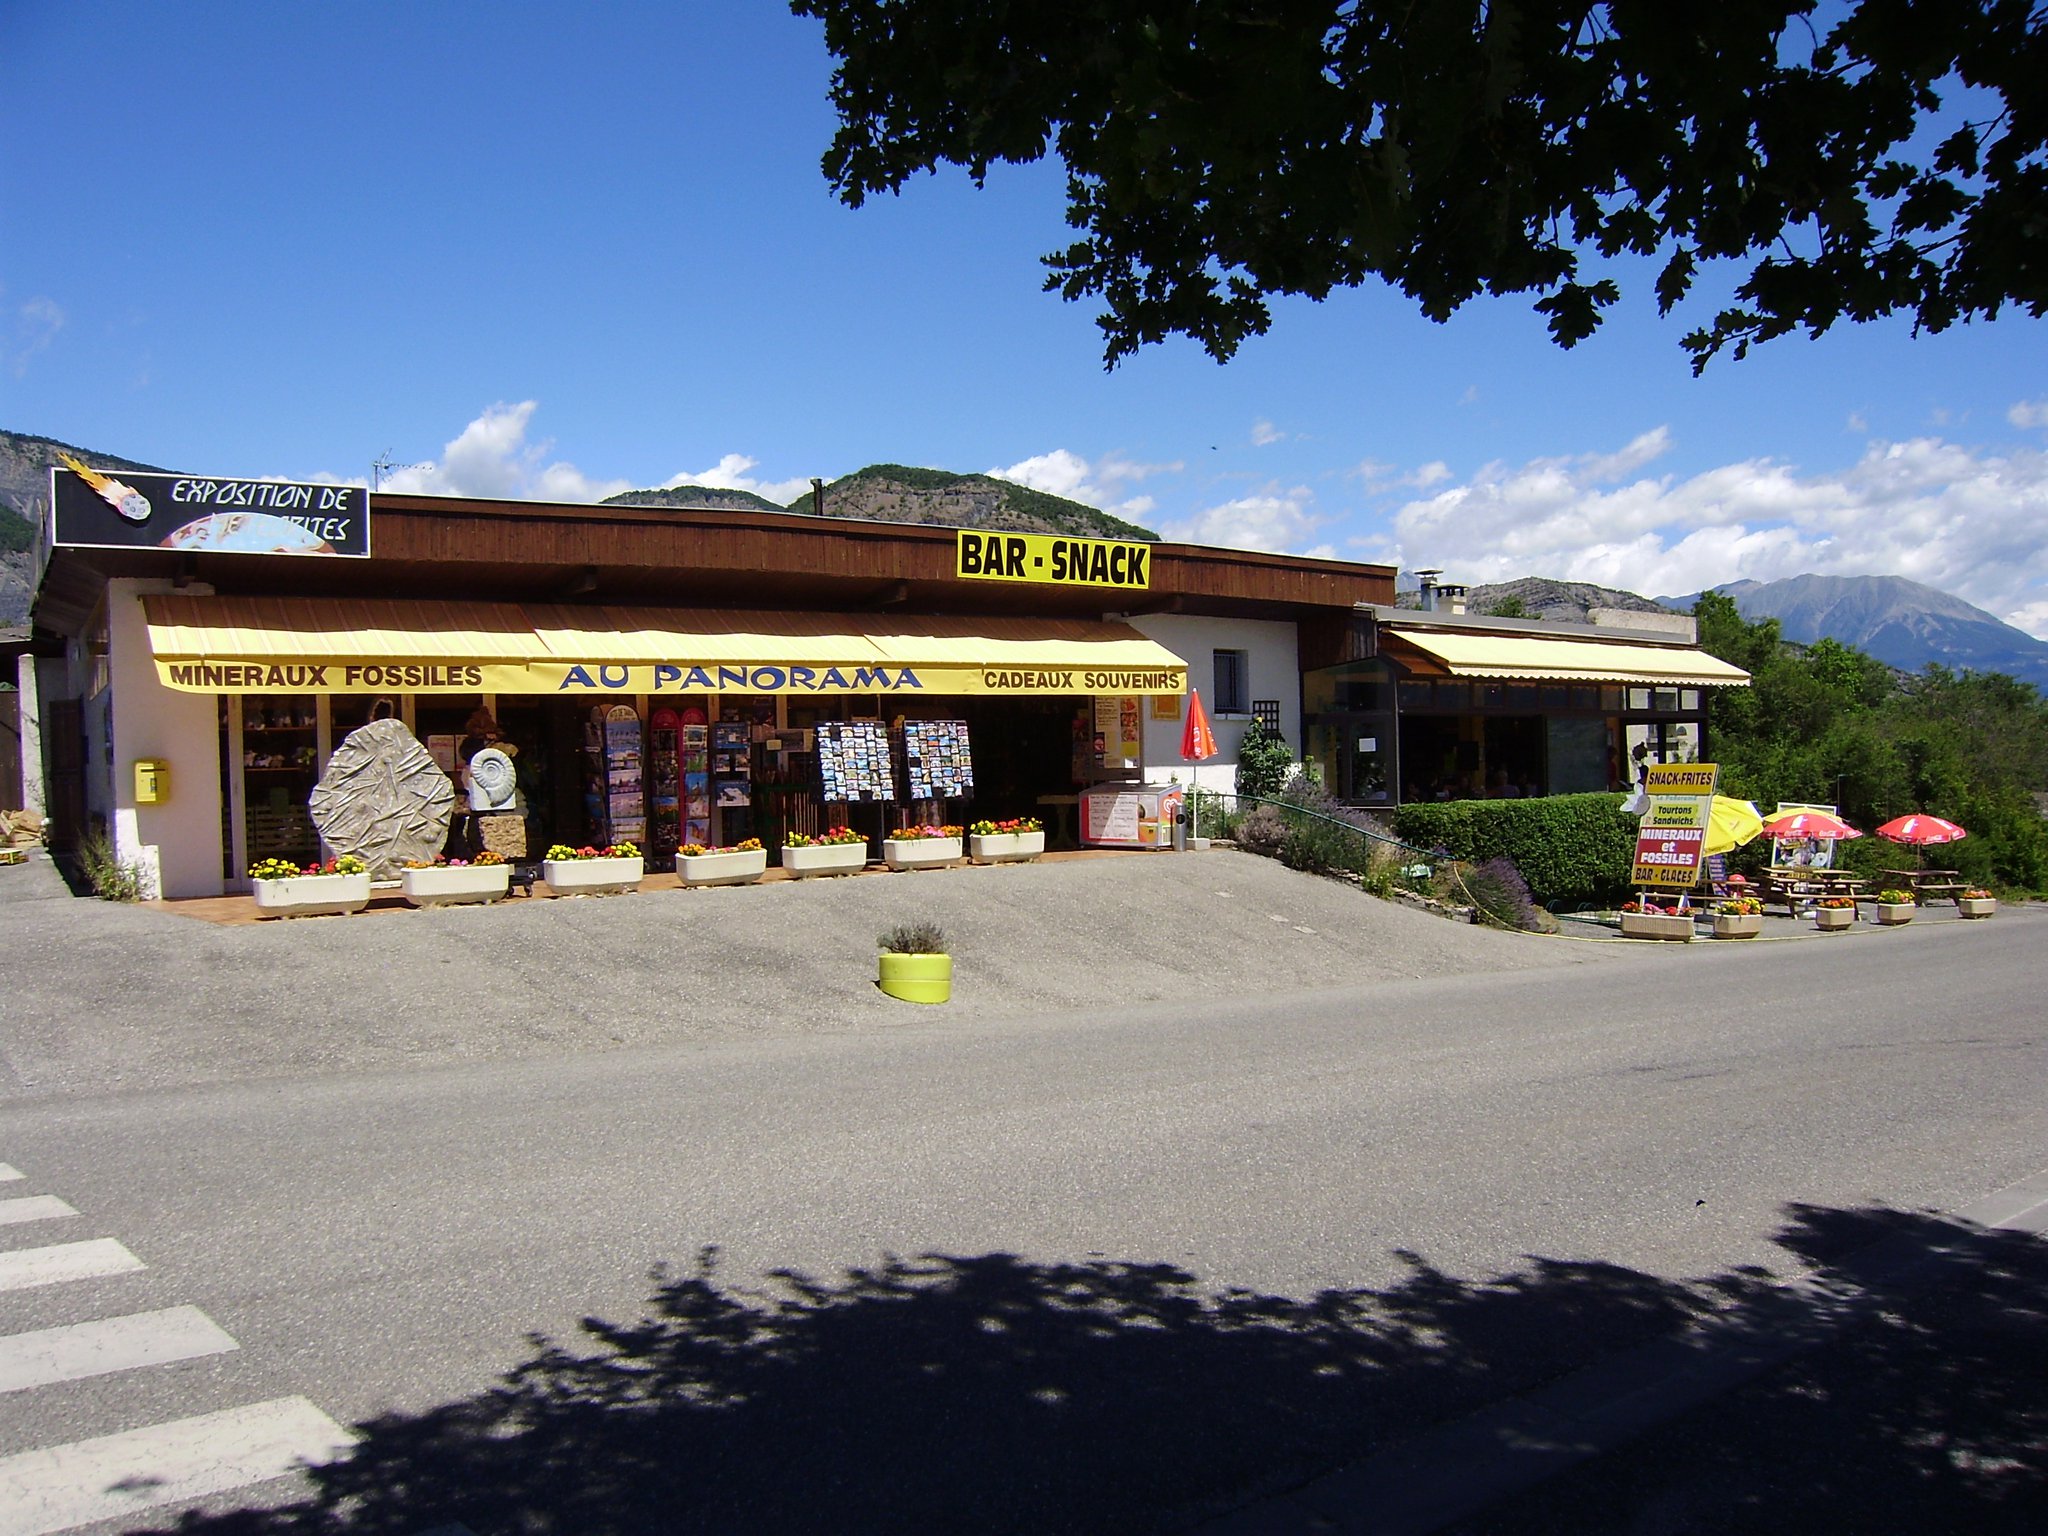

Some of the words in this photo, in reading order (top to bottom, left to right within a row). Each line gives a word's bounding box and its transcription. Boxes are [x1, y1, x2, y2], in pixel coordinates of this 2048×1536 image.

[172, 480, 313, 508] EXPOSITION
[319, 488, 352, 510] DE
[961, 534, 1027, 577] BAR
[1051, 540, 1147, 586] SNACK
[169, 665, 328, 686] MINERAUX
[345, 665, 482, 686] FOSSILES
[558, 665, 630, 690] AU
[653, 665, 924, 691] PANORAMA
[984, 671, 1074, 689] CADEAUX
[1084, 671, 1180, 691] SOUVENIRS
[1658, 806, 1692, 815] Tourtons
[1653, 817, 1694, 825] Sandwichs
[1640, 829, 1702, 840] MINERAUX
[1661, 841, 1675, 852] et
[1640, 852, 1693, 864] FOSSILES
[1635, 868, 1653, 880] BAR
[1660, 868, 1692, 883] GLACES
